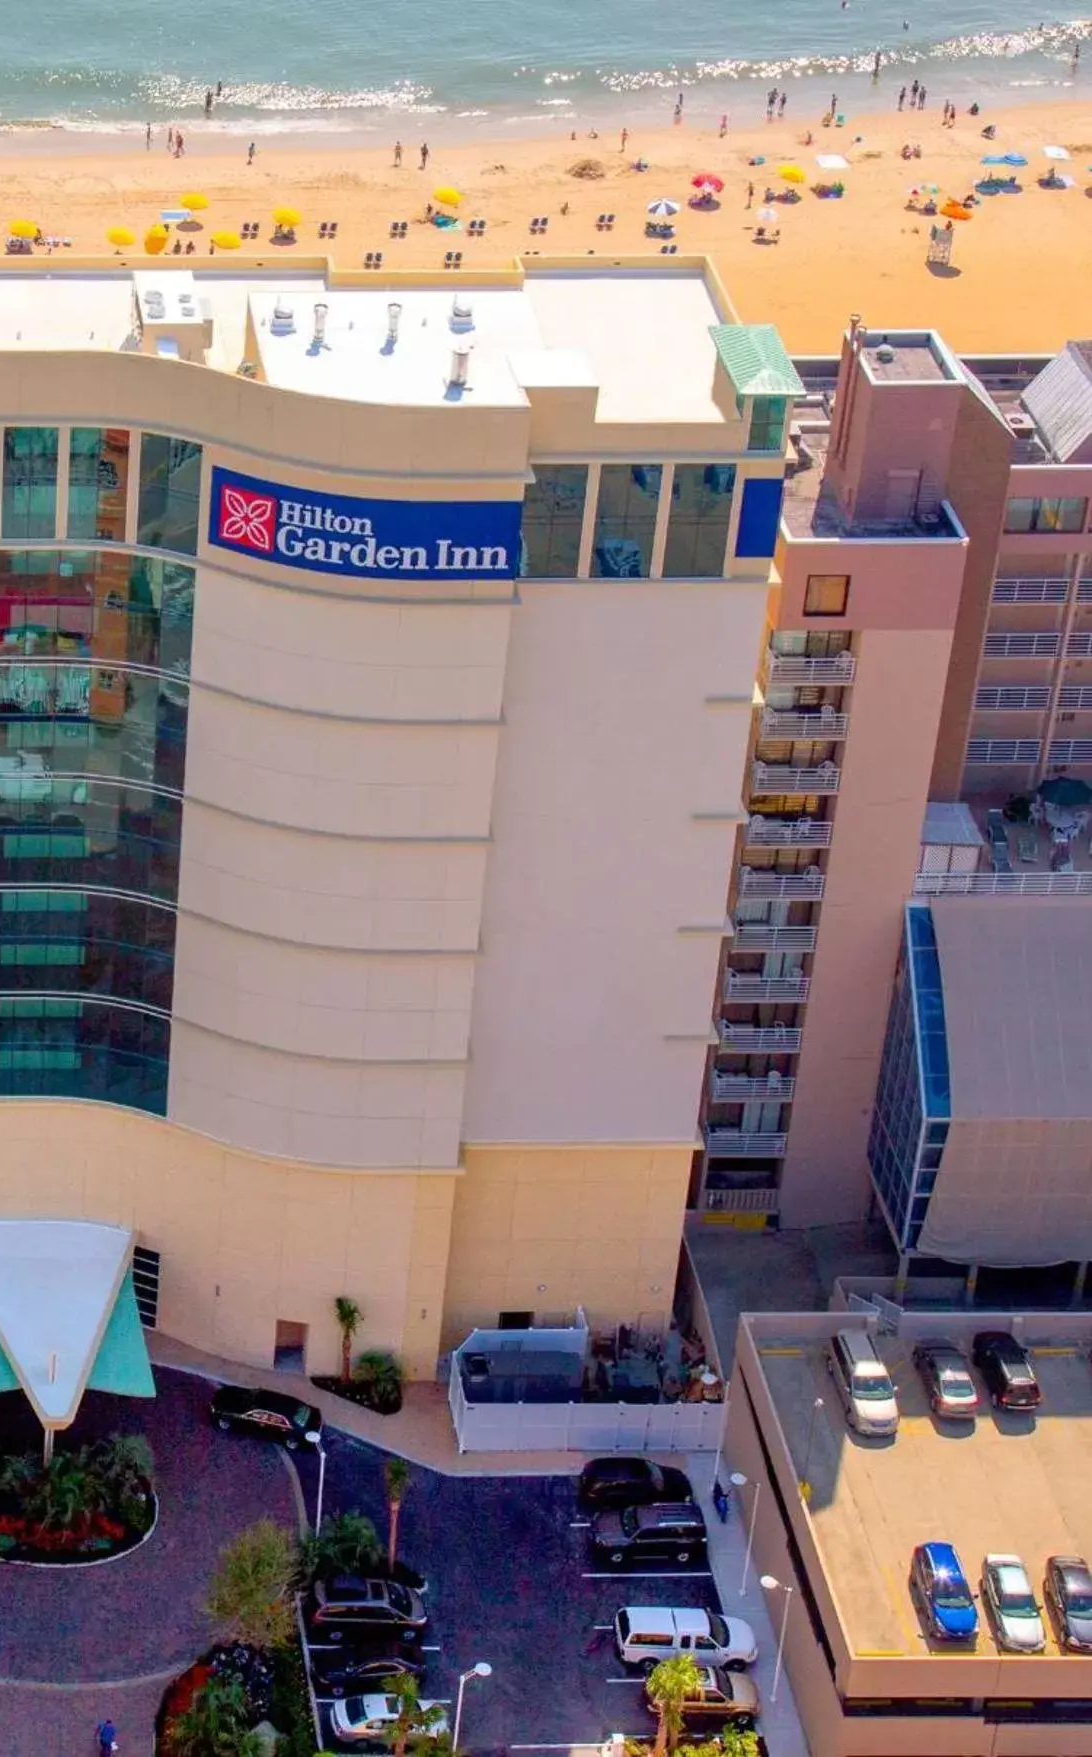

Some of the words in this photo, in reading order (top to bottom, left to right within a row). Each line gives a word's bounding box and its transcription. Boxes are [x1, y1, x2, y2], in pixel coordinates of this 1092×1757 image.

[279, 499, 373, 536] Hilton
[276, 525, 429, 570] Garden
[434, 539, 509, 570] Inn
